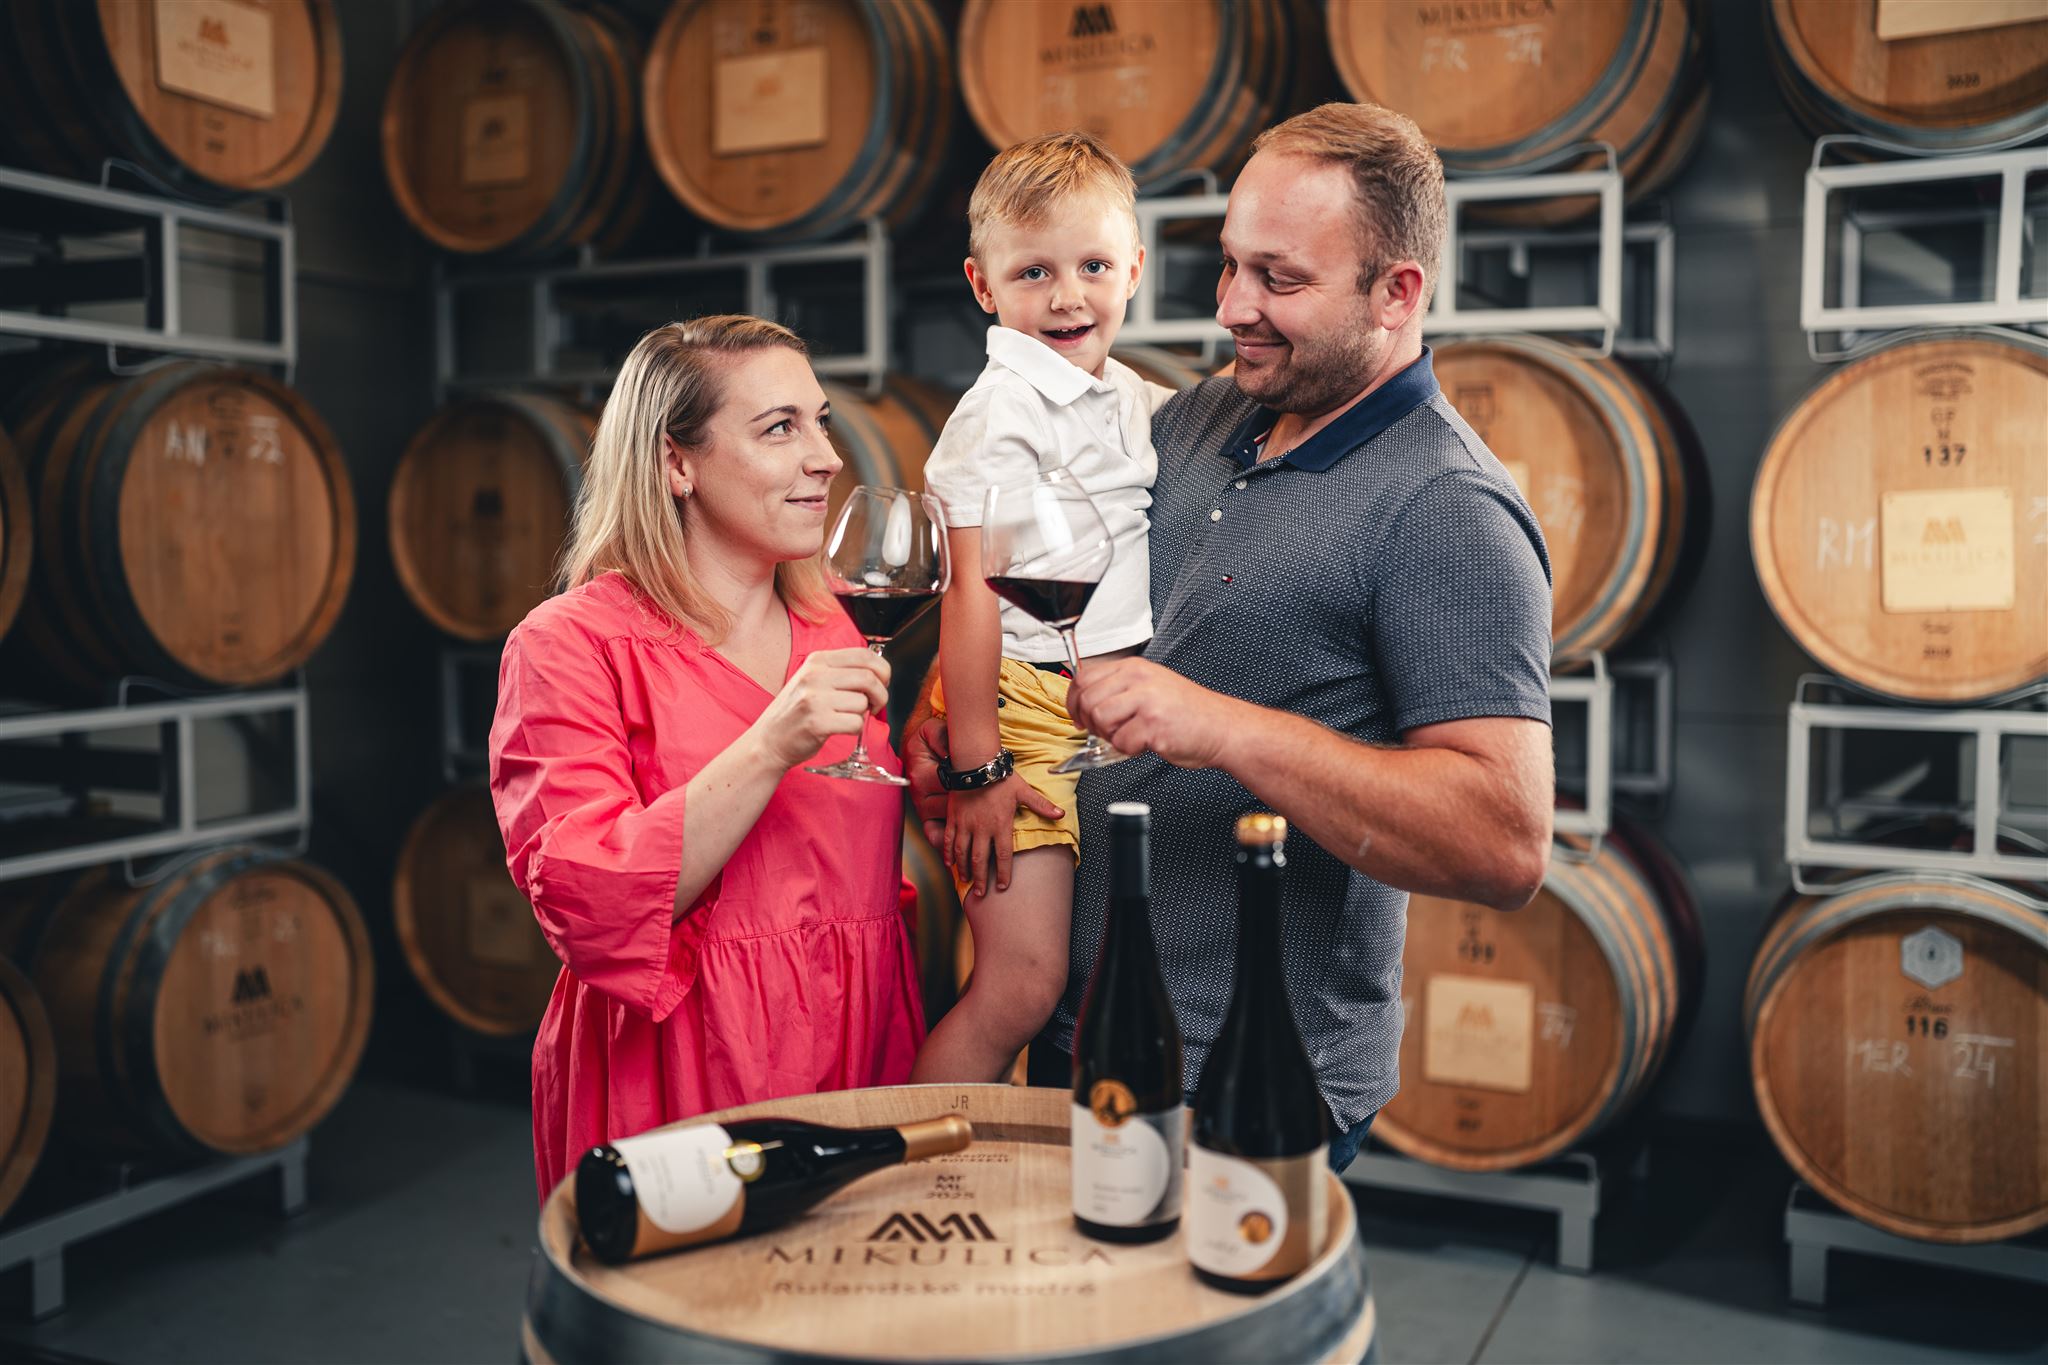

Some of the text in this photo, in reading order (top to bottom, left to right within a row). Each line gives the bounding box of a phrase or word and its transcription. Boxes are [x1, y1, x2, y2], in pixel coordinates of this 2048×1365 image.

[1923, 444, 1967, 467] 137
[1816, 516, 1877, 571] RM
[1905, 1014, 1949, 1041] 116
[951, 1095, 969, 1110] JR
[766, 1246, 1114, 1267] MIKULICA
